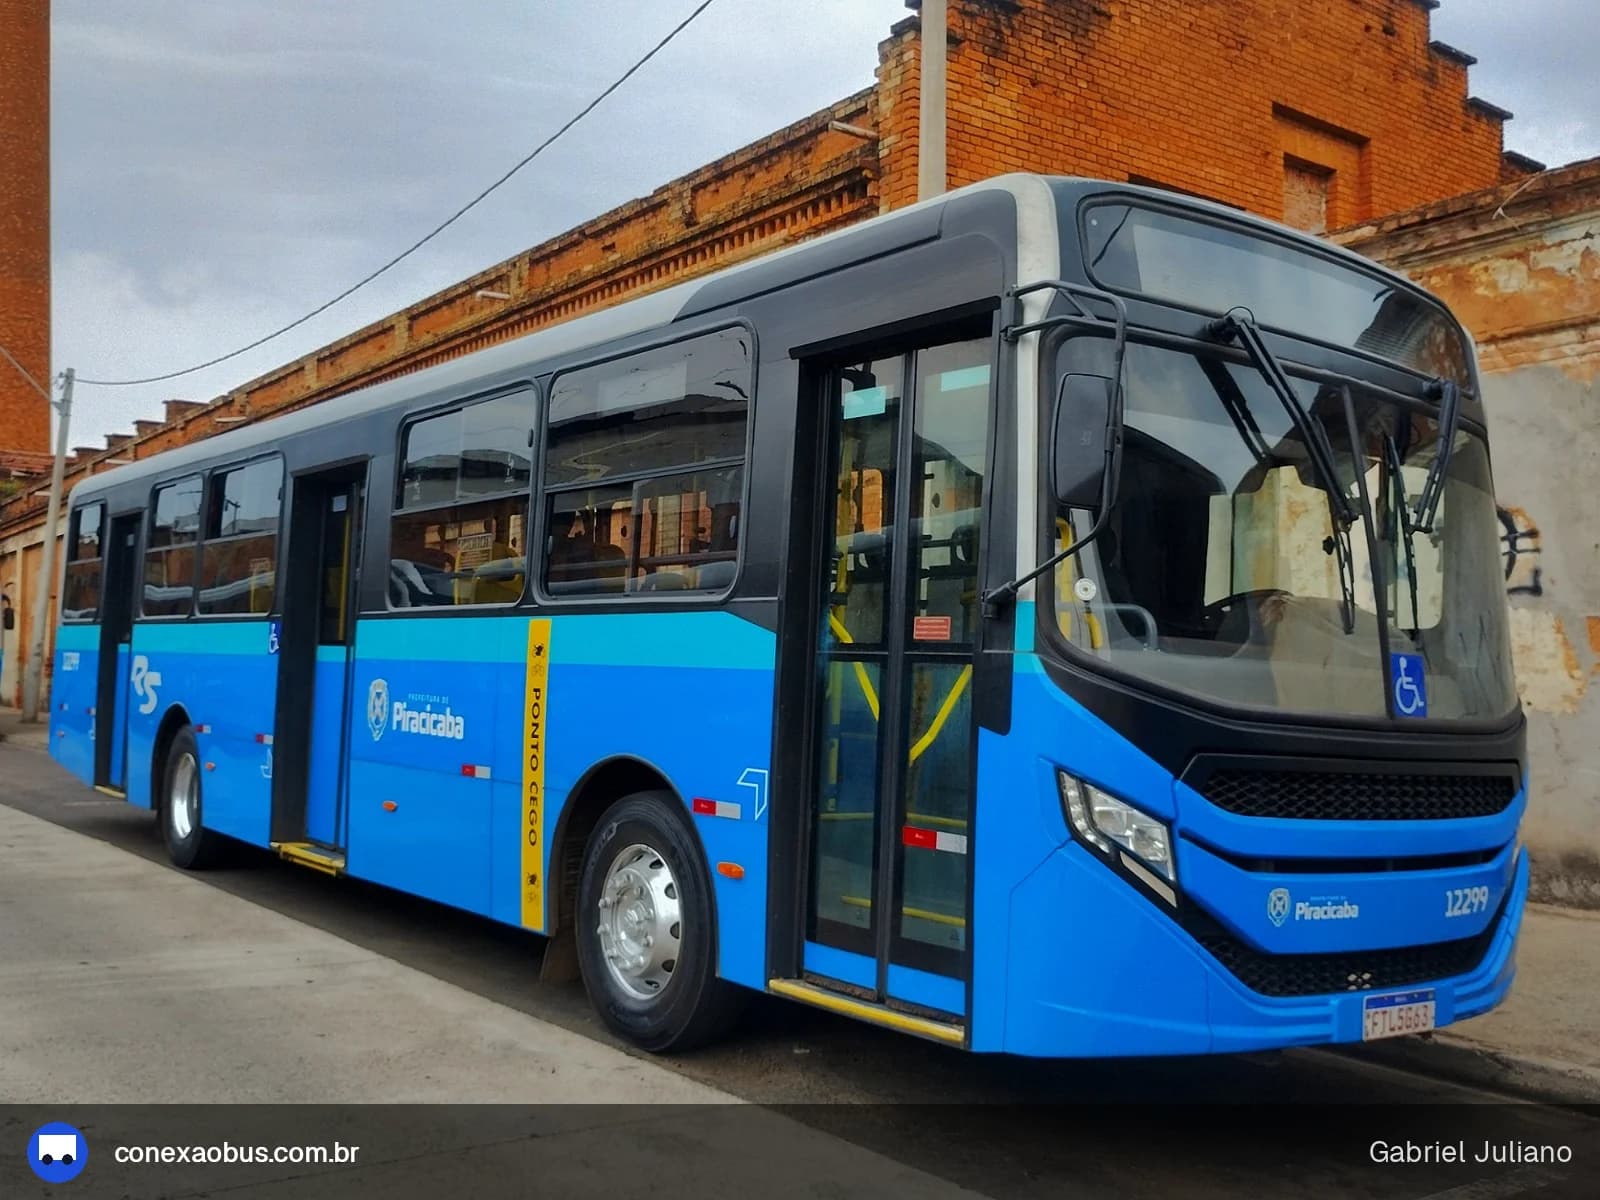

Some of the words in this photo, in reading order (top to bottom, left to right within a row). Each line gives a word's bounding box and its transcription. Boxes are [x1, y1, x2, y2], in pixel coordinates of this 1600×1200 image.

[392, 701, 465, 740] Piracicaba
[529, 687, 542, 771] PONTO
[527, 782, 539, 847] CEGO
[1295, 900, 1359, 921] Piracicaba
[1444, 885, 1489, 918] 12299
